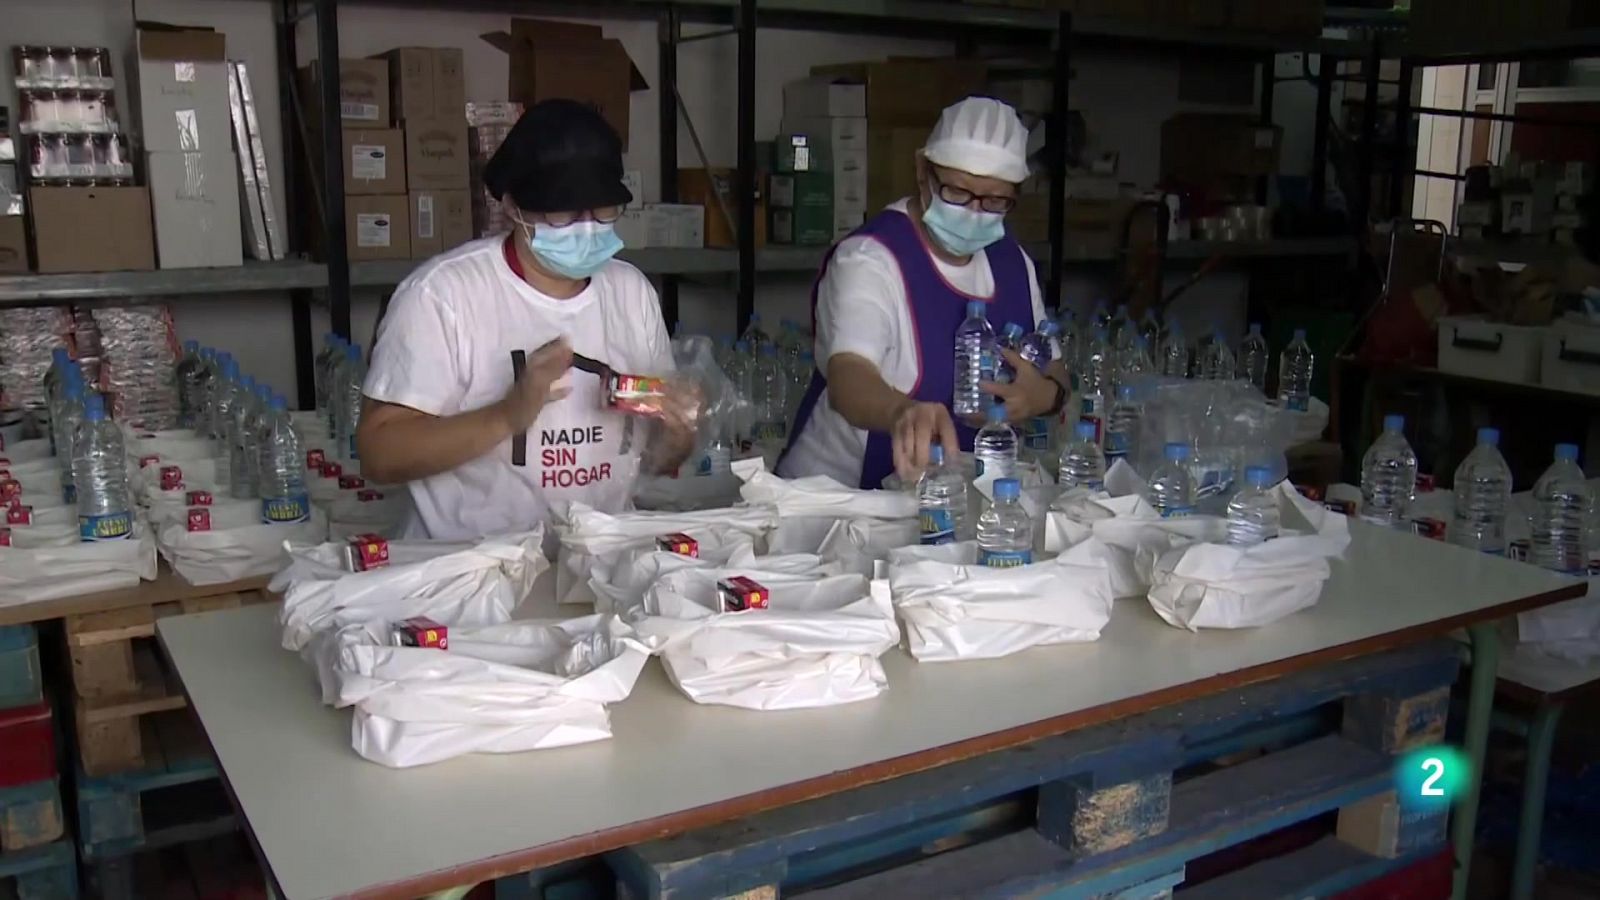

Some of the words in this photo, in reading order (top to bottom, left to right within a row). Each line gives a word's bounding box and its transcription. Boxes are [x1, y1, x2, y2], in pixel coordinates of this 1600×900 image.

[541, 426, 603, 446] NADIE
[542, 448, 576, 467] SIN
[542, 463, 611, 488] HOGAR
